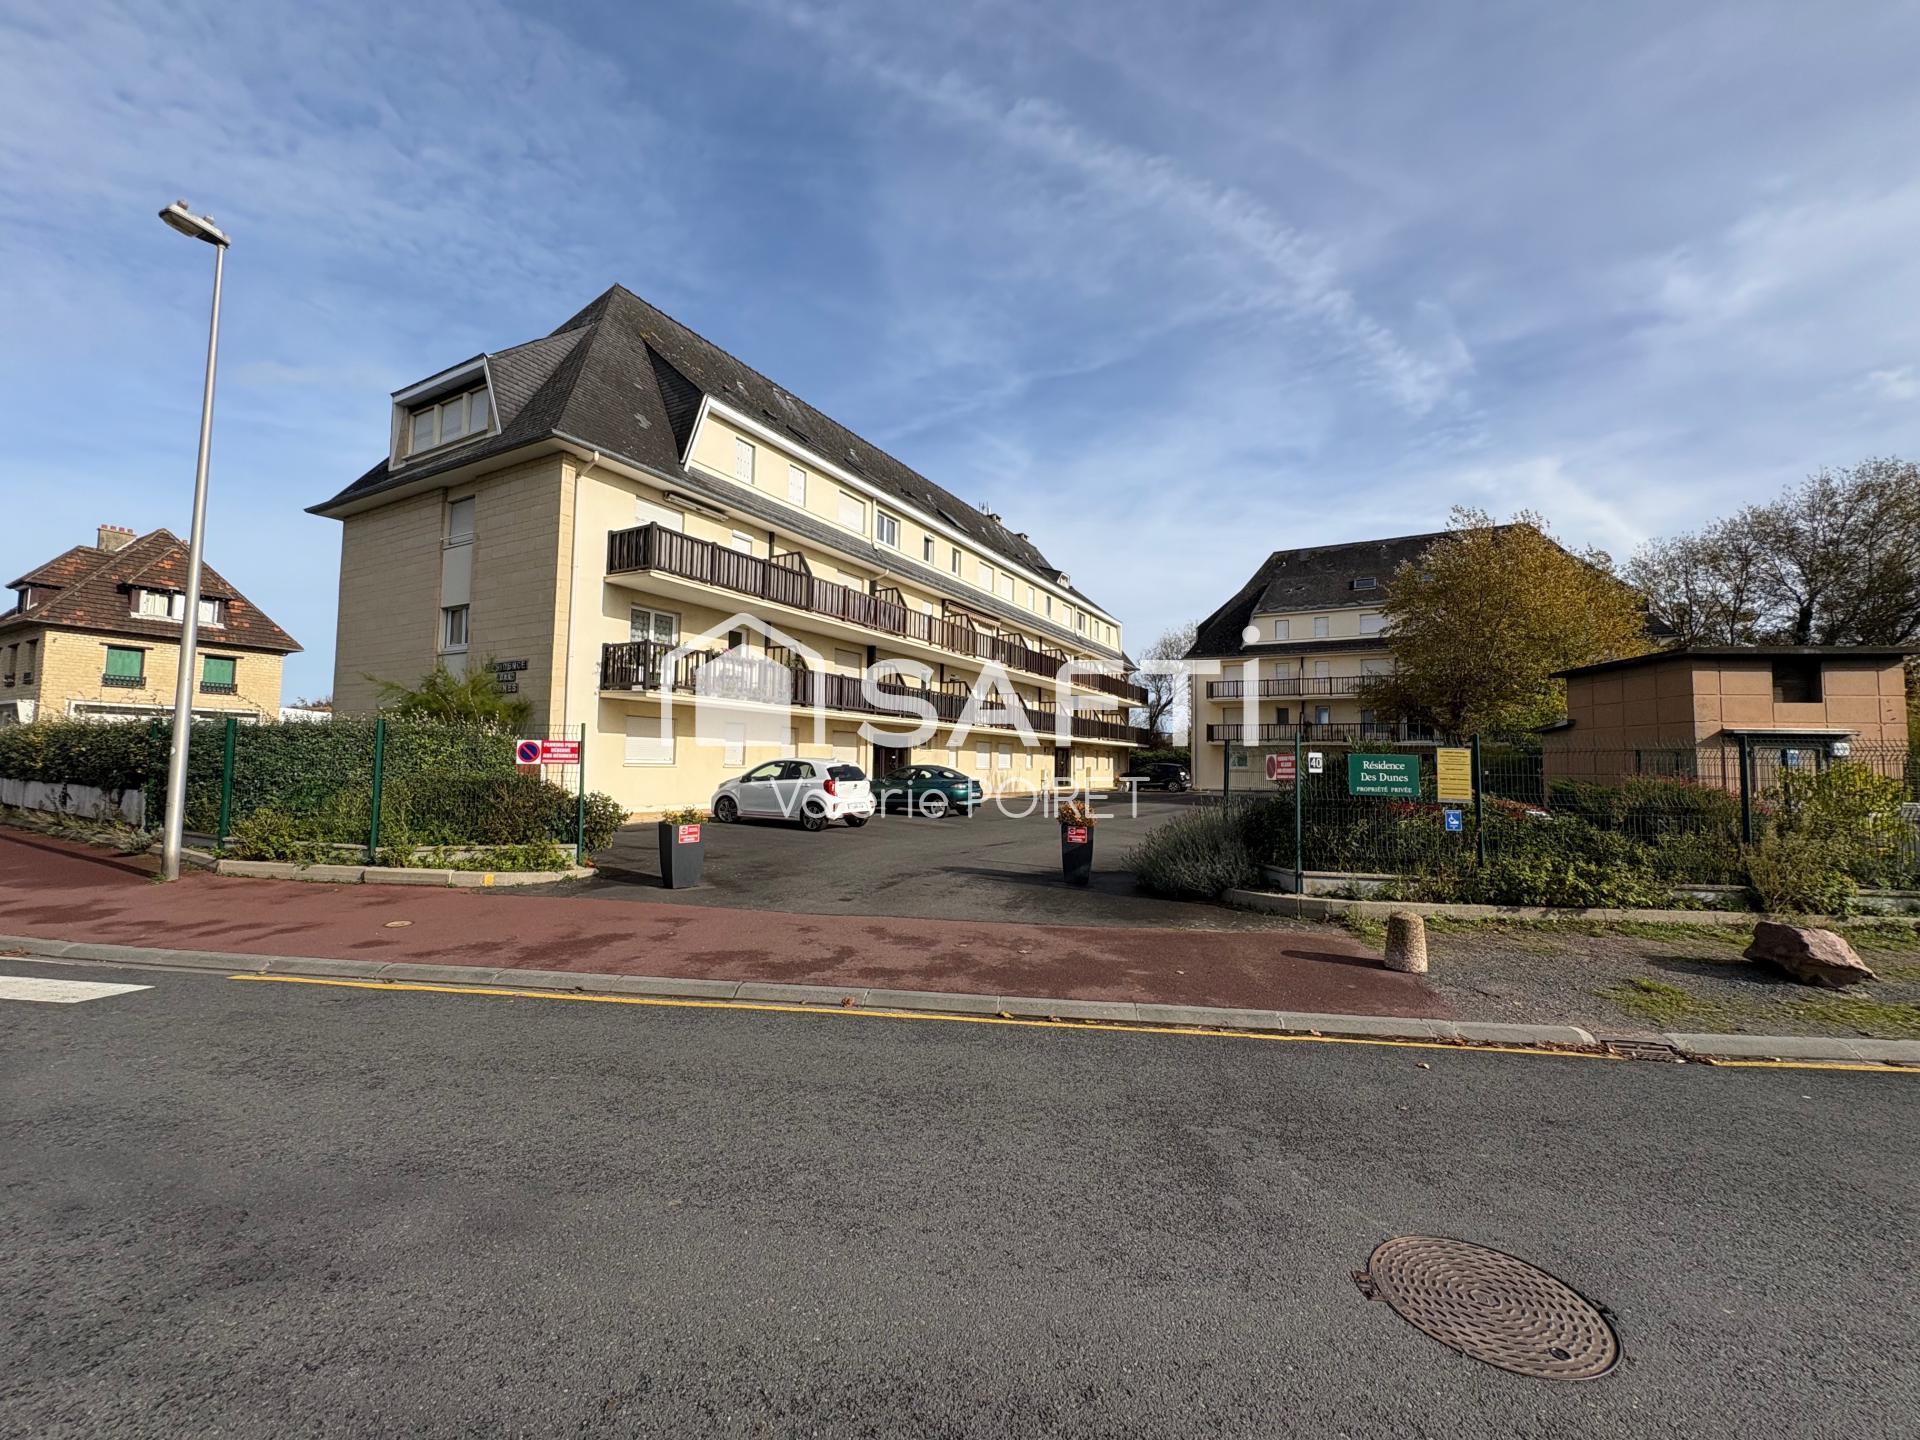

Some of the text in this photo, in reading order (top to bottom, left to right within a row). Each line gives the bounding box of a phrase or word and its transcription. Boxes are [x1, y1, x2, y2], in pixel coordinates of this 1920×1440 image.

[1310, 758, 1321, 768] 40
[1362, 760, 1405, 770] Résidence
[1360, 772, 1409, 782] Des Dunes
